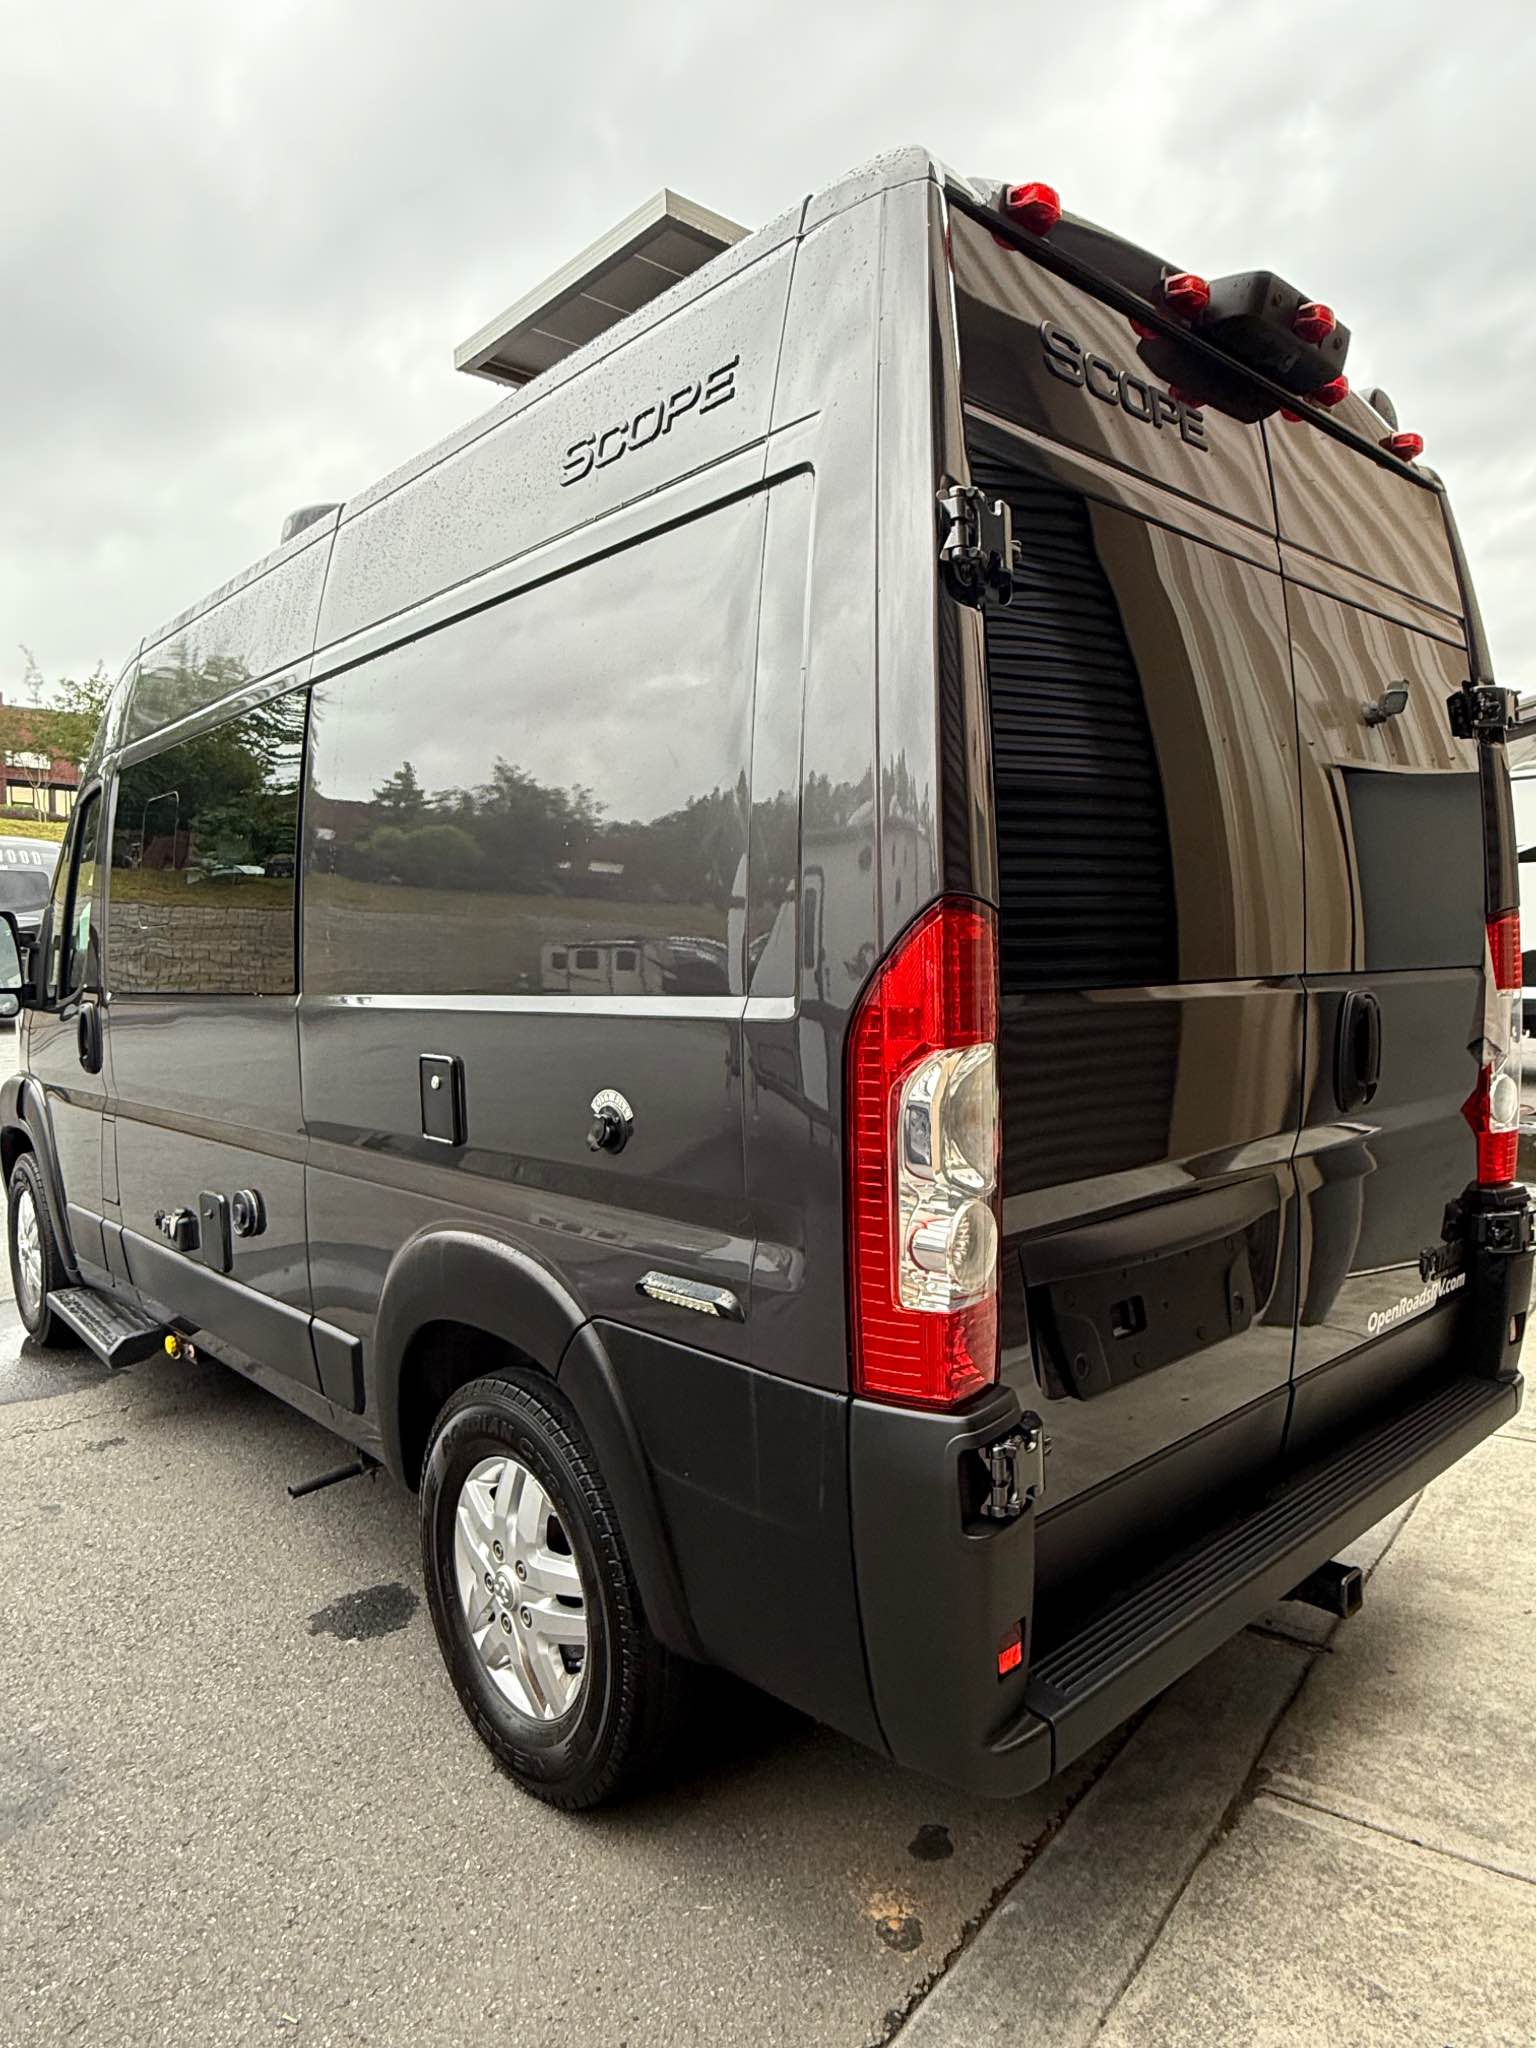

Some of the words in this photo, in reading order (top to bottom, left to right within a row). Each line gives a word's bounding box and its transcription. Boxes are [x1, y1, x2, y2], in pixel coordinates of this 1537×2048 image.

[561, 354, 739, 486] SCOPE
[1039, 320, 1208, 452] SCOPE
[1367, 1272, 1466, 1334] OpenRoadsRV.com
